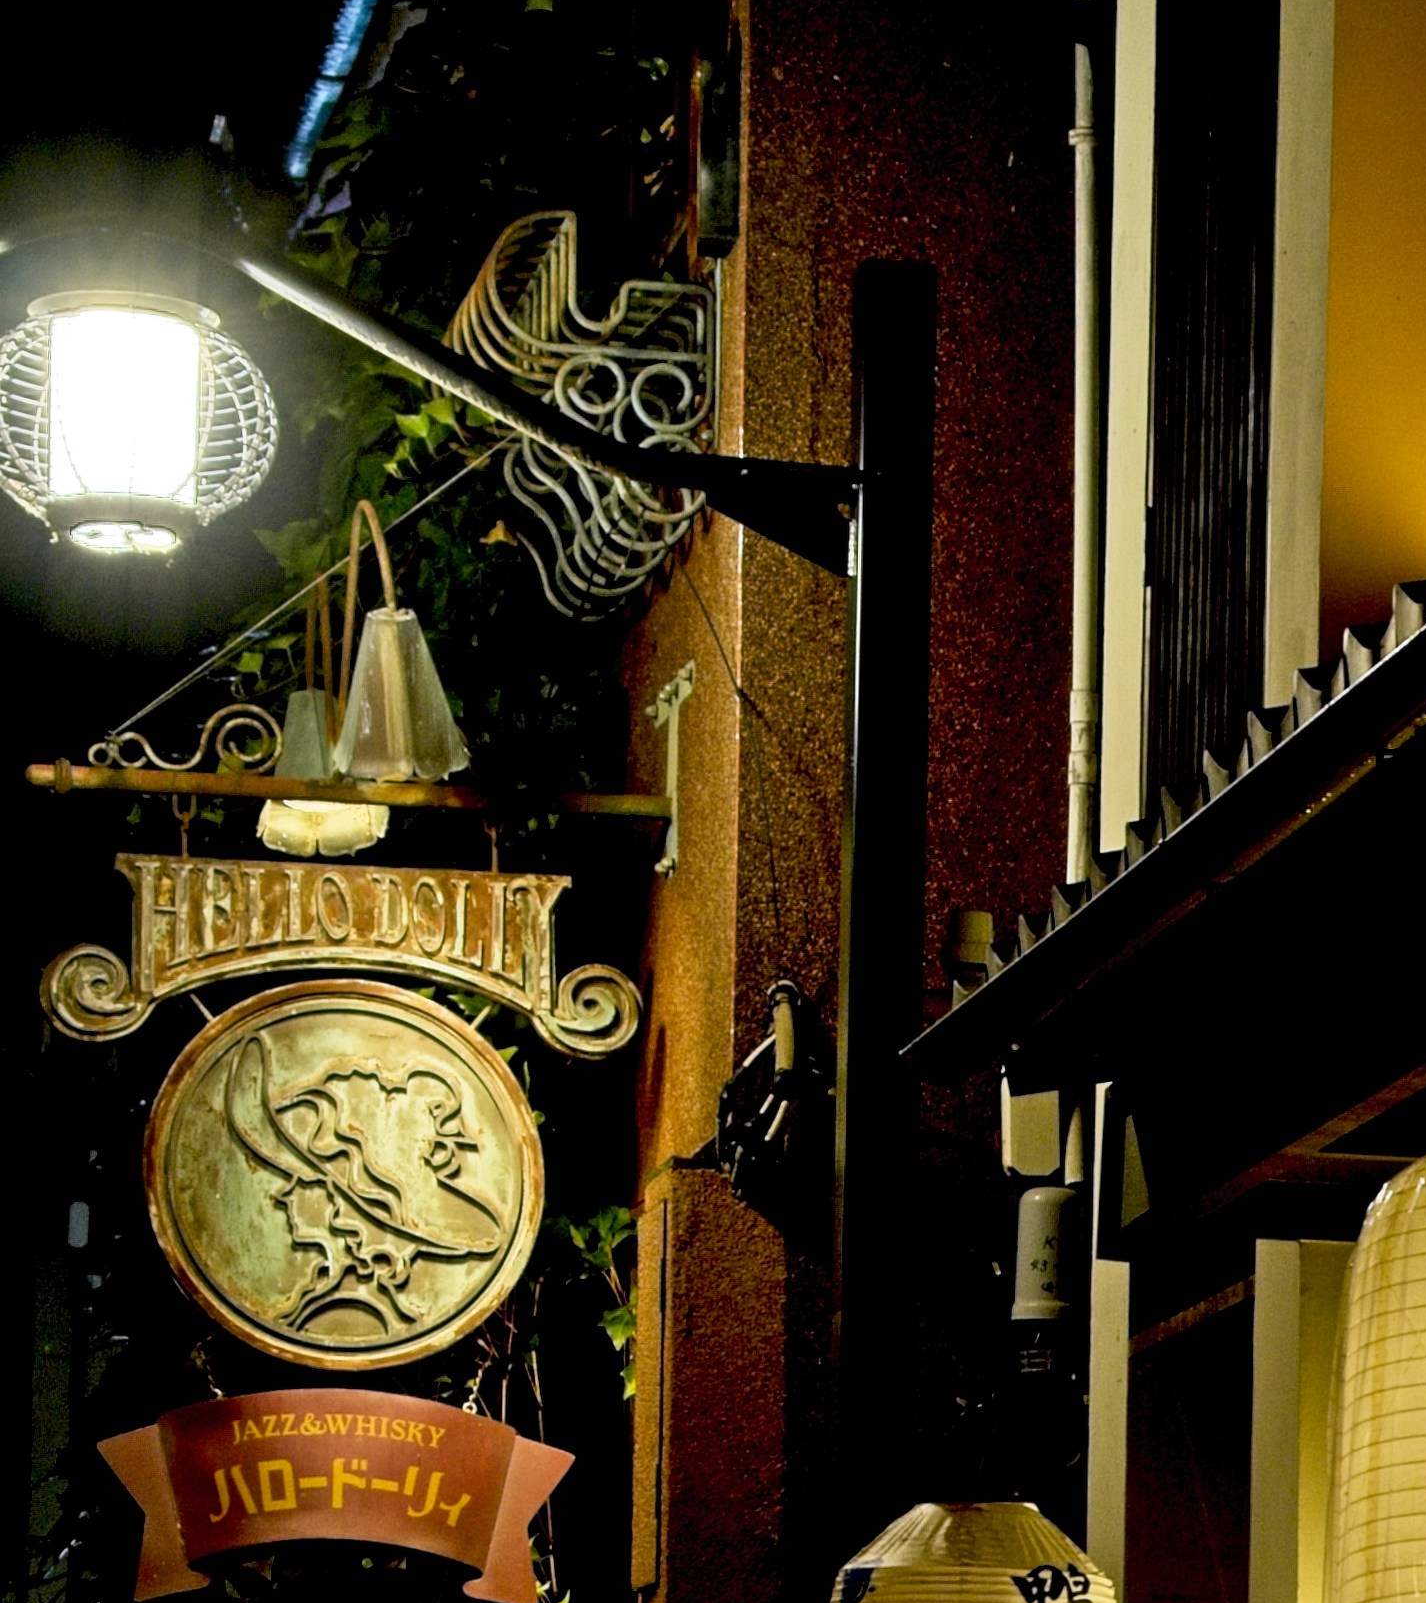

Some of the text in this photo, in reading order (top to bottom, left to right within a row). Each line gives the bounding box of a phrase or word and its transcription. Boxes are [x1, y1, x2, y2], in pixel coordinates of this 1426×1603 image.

[134, 861, 573, 1016] HELLO DOLLY
[231, 1412, 446, 1448] JAZZ&WHISKY
